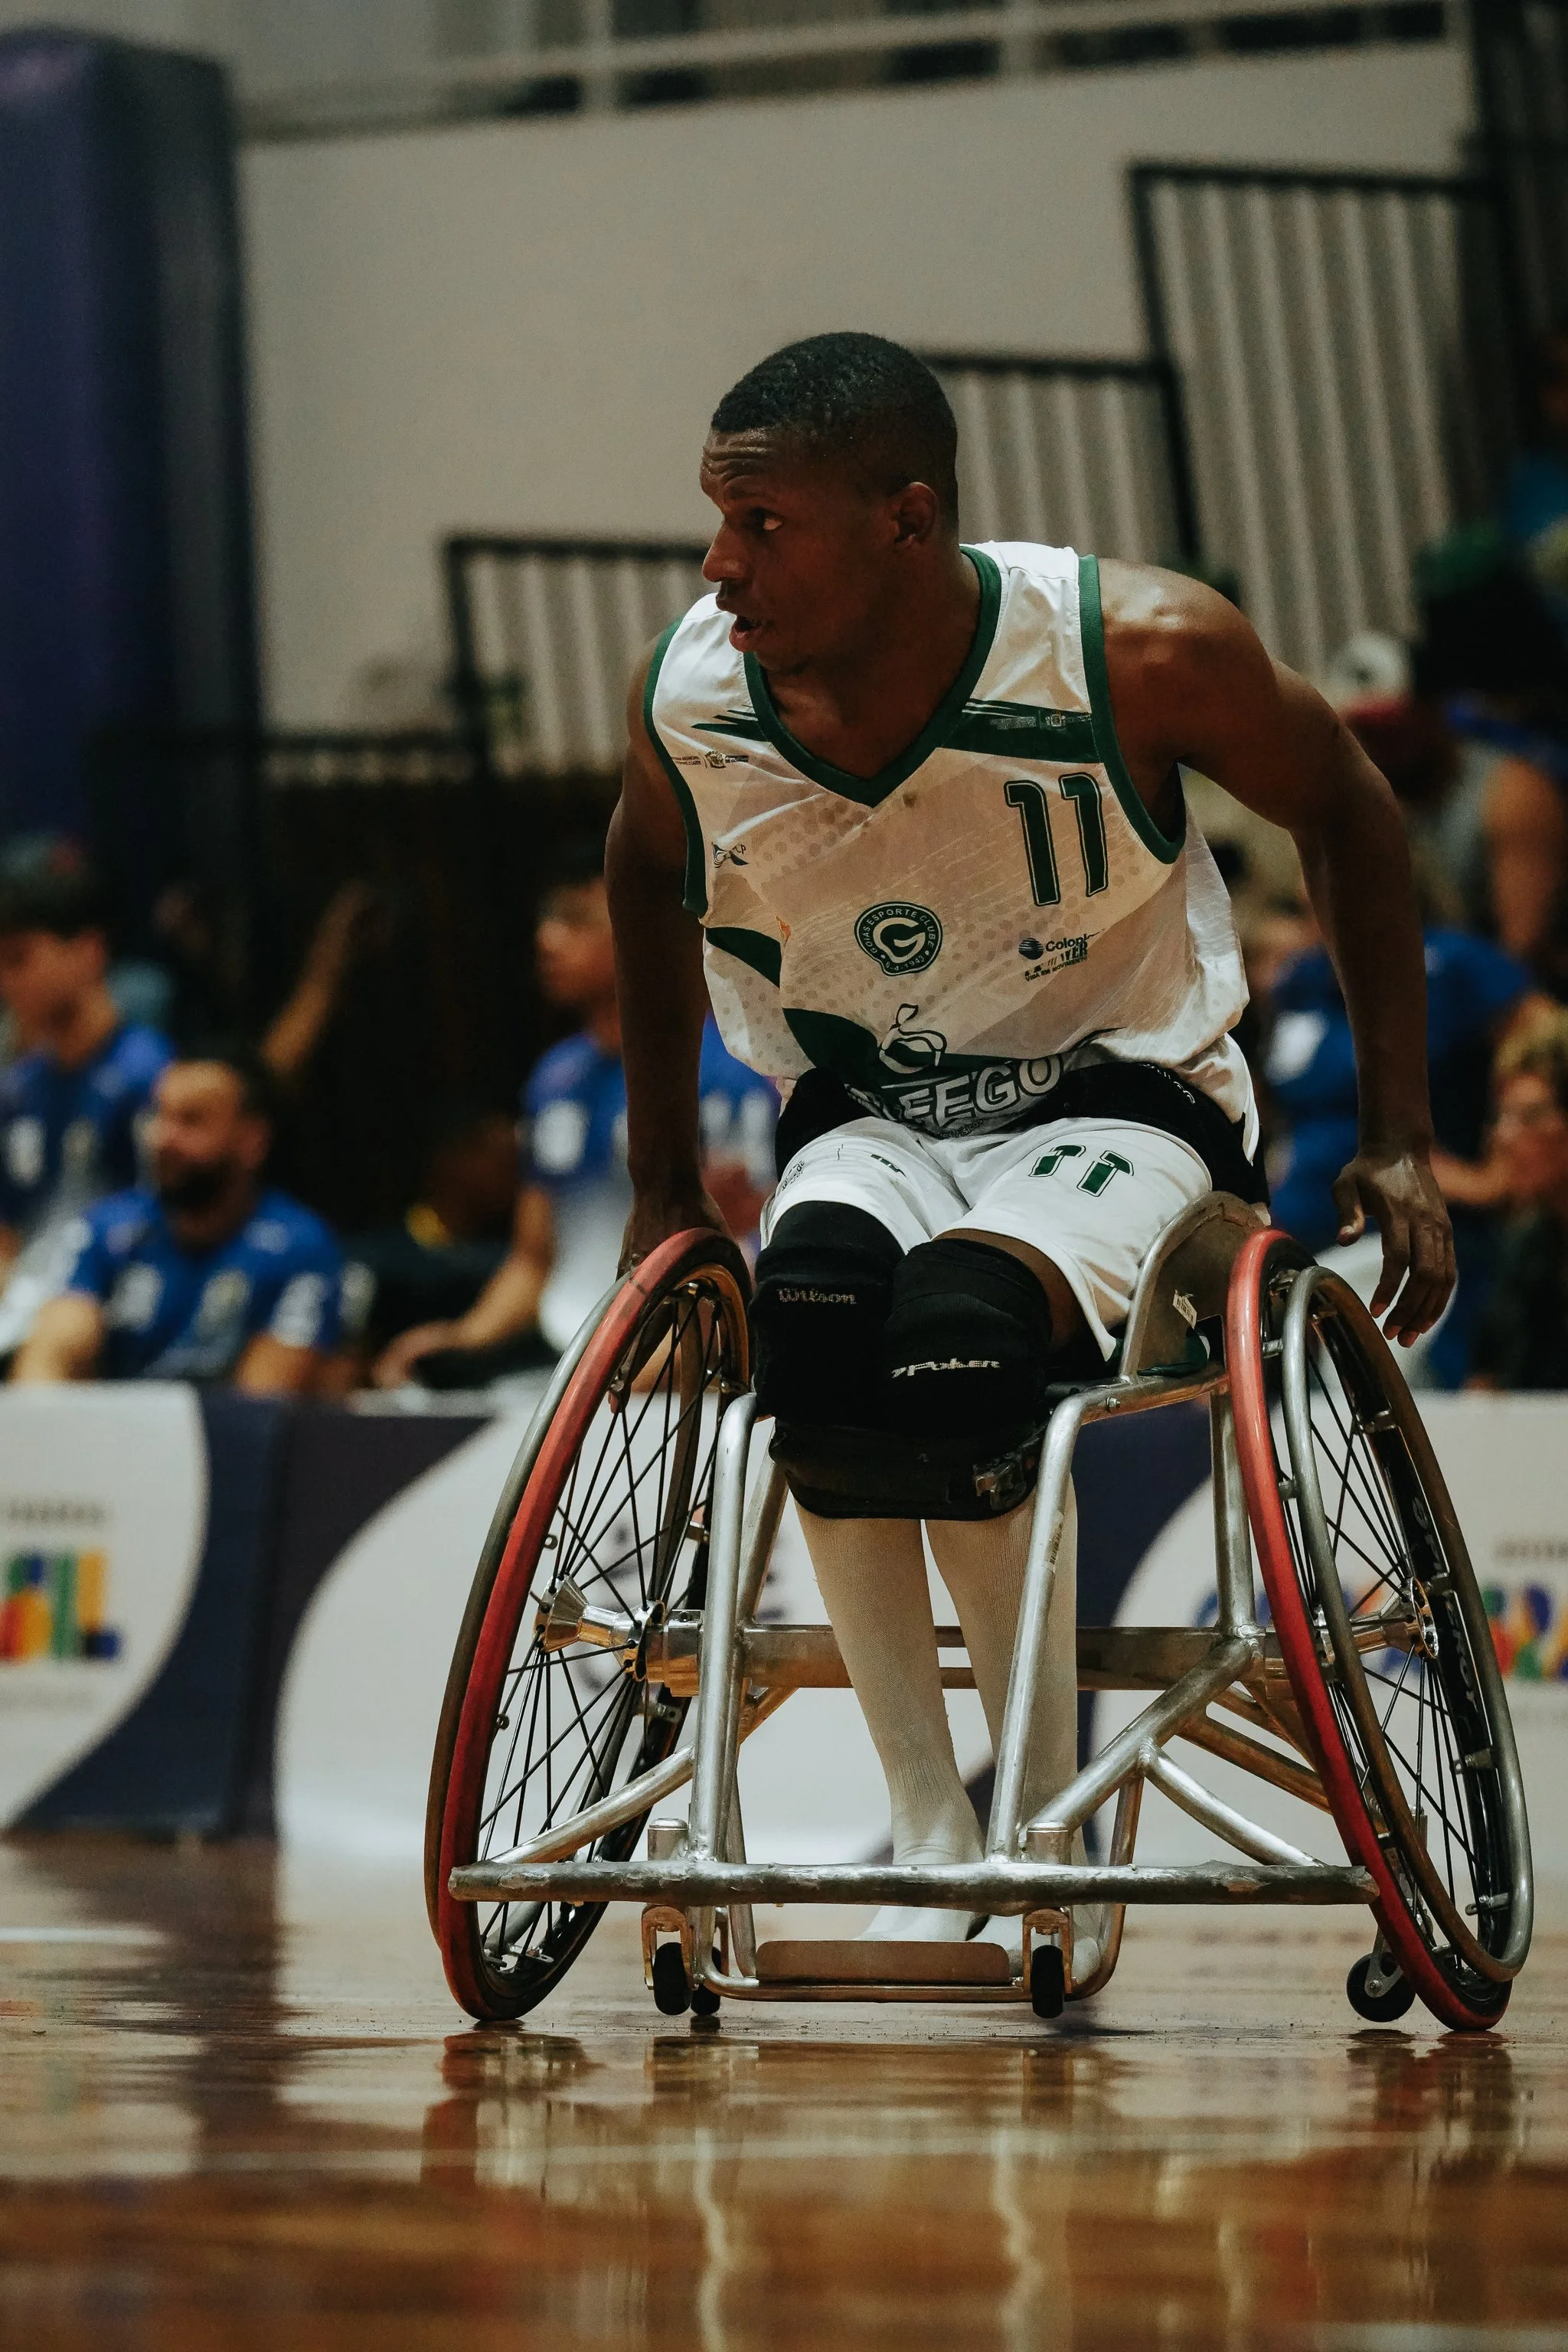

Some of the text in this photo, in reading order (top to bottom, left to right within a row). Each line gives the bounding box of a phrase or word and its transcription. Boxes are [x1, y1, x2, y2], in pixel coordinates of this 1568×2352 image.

[1004, 772, 1109, 906] 11
[866, 908, 918, 926] ESPORTE
[920, 914, 936, 949] CLUBE
